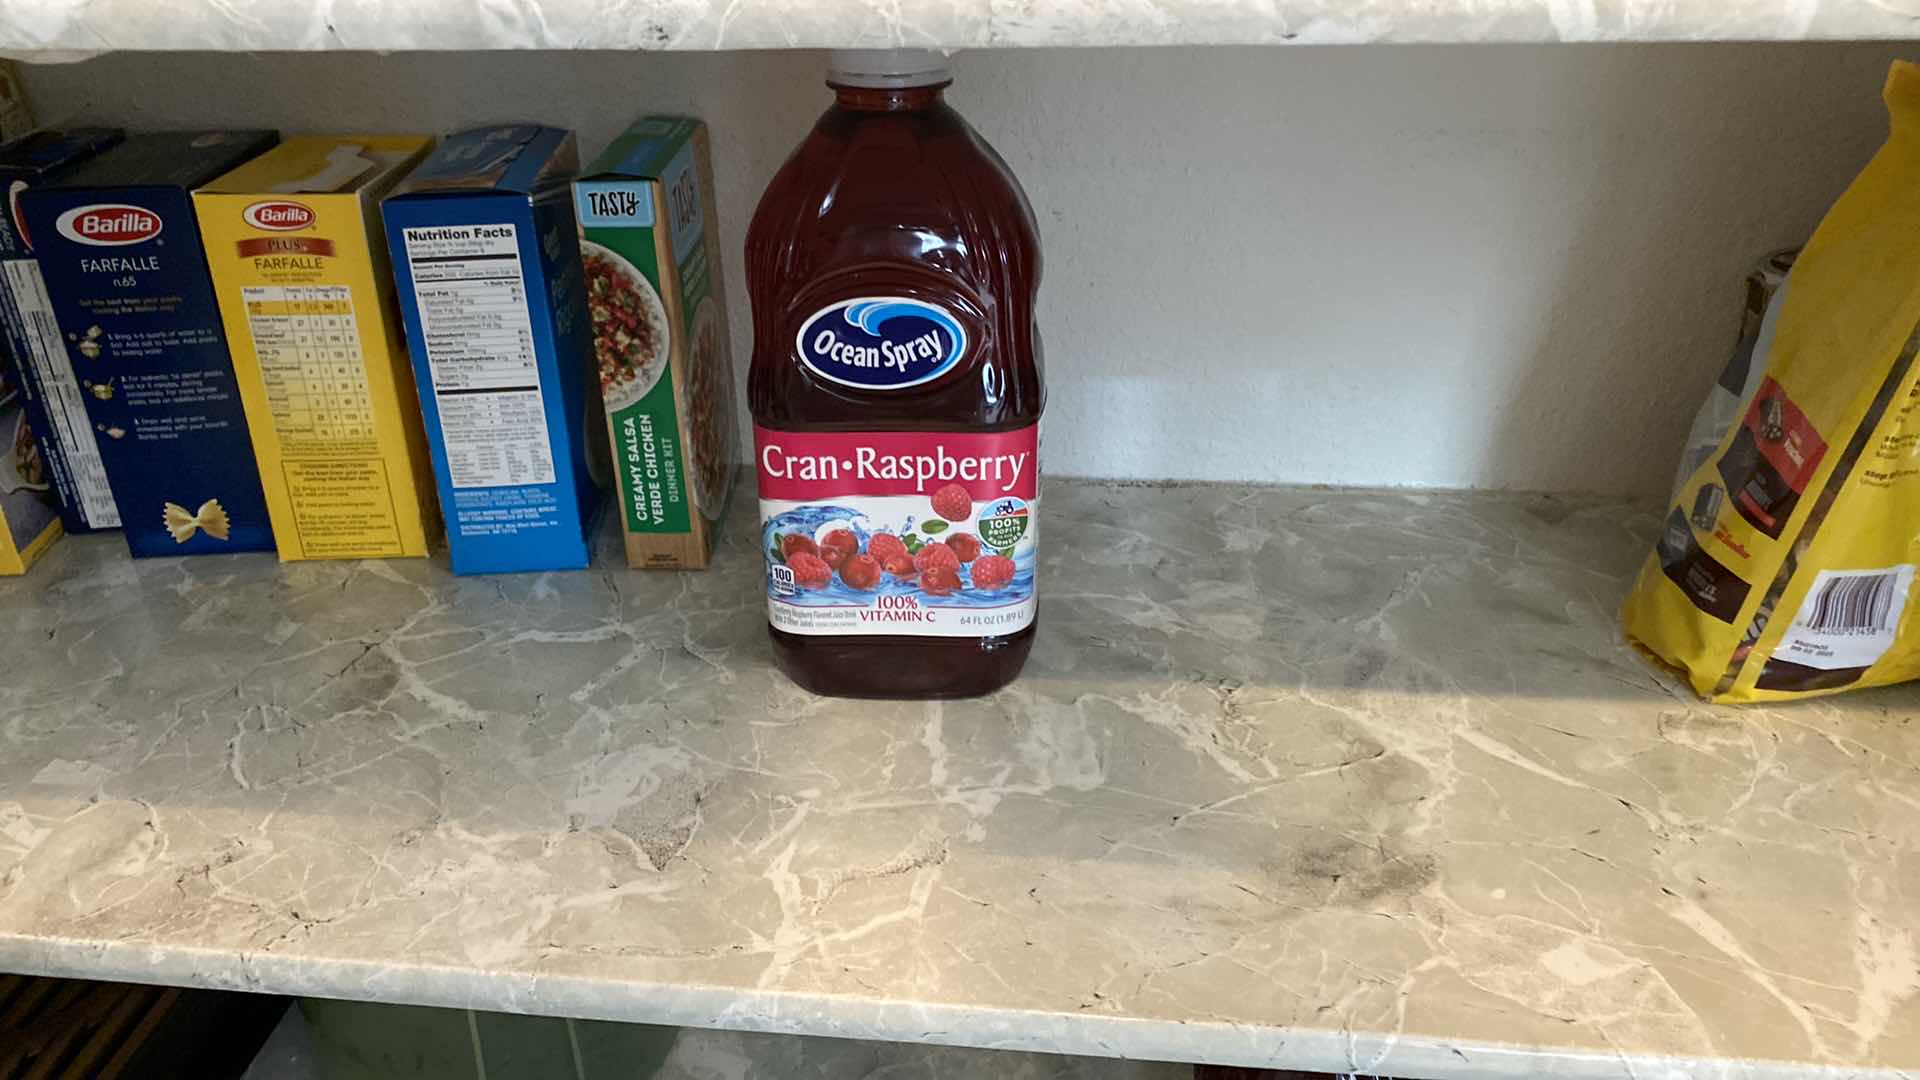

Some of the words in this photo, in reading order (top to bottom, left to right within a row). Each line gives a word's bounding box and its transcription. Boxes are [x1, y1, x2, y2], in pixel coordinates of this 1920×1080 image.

[588, 191, 640, 217] TASTY
[261, 207, 308, 222] Barilla
[82, 214, 153, 233] Barilla
[407, 230, 470, 242] Nutrition
[474, 227, 513, 238] Facts
[81, 256, 160, 273] FARFALLE
[254, 258, 324, 270] FARFALLE
[113, 275, 137, 288] n.65
[813, 330, 879, 368] Ocean
[884, 329, 942, 373] Spray
[623, 416, 640, 464] SALSA
[639, 414, 659, 479] CHICKEN
[661, 437, 674, 458] KIT
[664, 459, 680, 503] DINNER
[628, 465, 648, 521] CREAMY
[648, 481, 665, 526] VERDE
[988, 526, 1021, 535] PROFITS
[989, 517, 1020, 529] 100%
[774, 567, 792, 583] 100
[878, 595, 918, 610] 100%
[860, 610, 925, 622] VITAMIN
[927, 611, 935, 622] C
[960, 616, 971, 624] 64
[973, 615, 982, 624] FL
[984, 614, 997, 624] OZ
